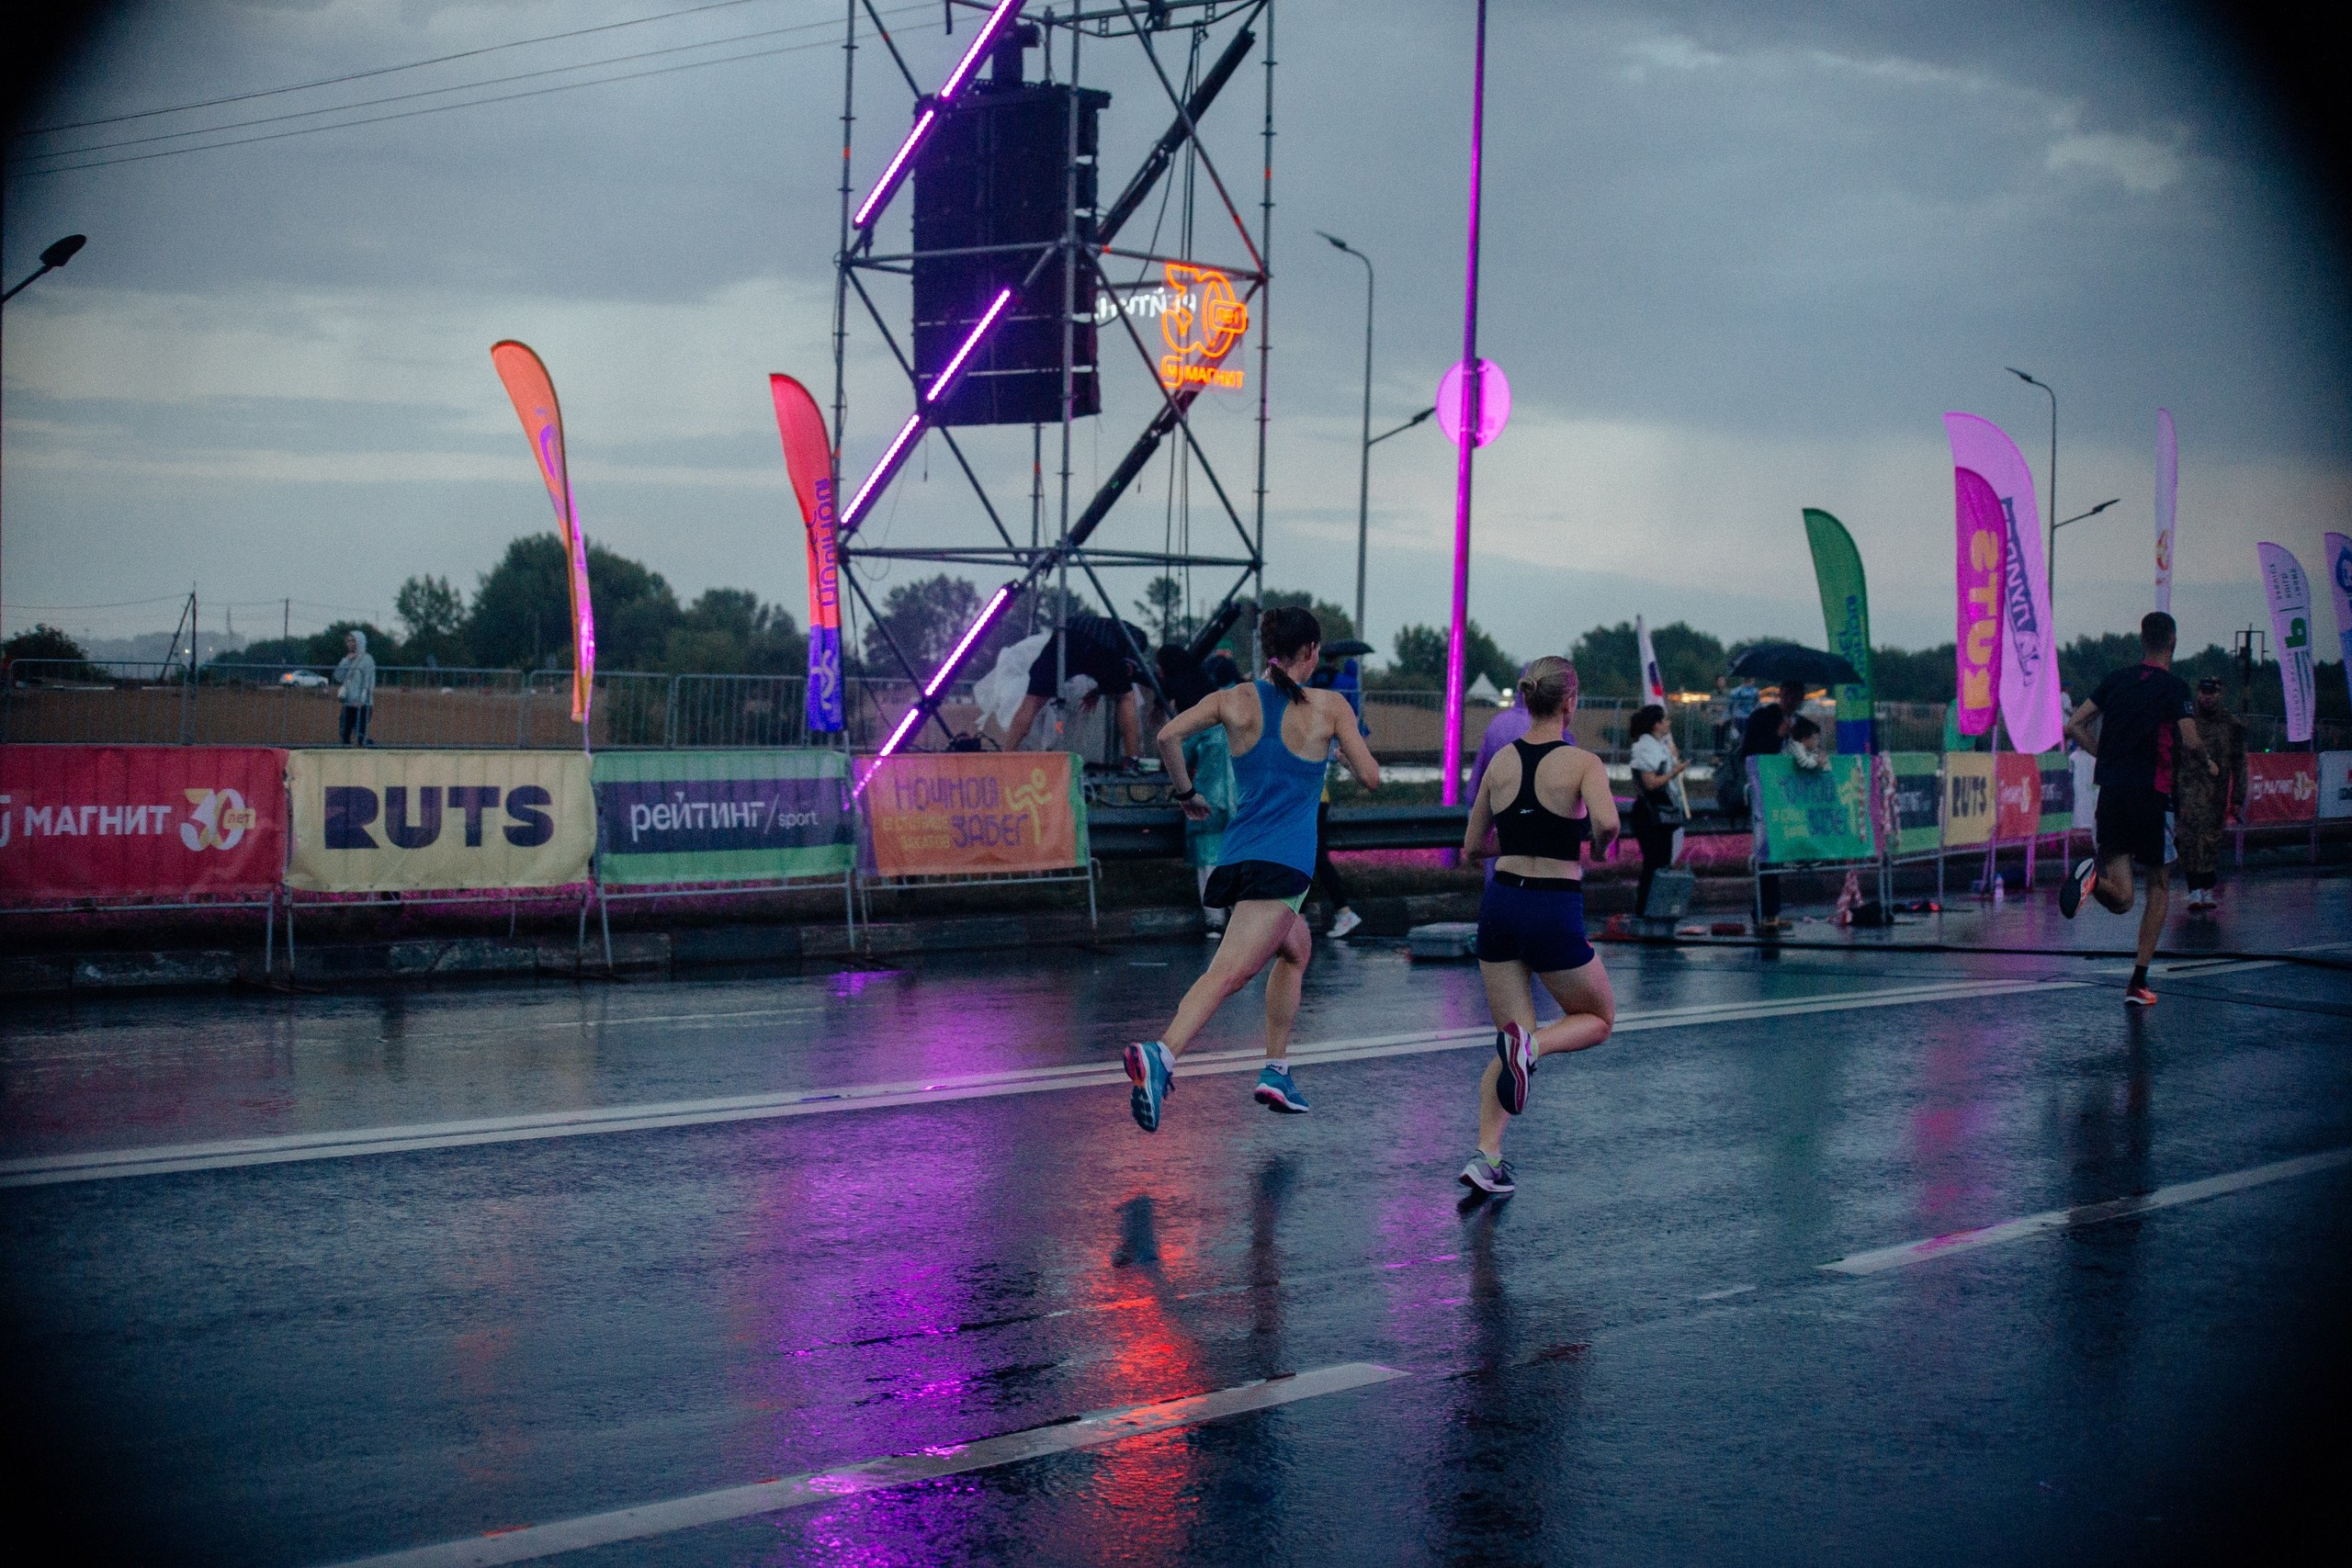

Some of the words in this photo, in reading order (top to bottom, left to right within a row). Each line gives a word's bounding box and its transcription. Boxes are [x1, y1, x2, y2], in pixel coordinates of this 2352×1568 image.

[1184, 365, 1245, 389] МАГНИТ
[1951, 776, 1987, 818] RUTS
[24, 805, 172, 837] МАГНИТ
[324, 785, 554, 850] RUTS
[951, 813, 1029, 849] ЗАБЕГ
